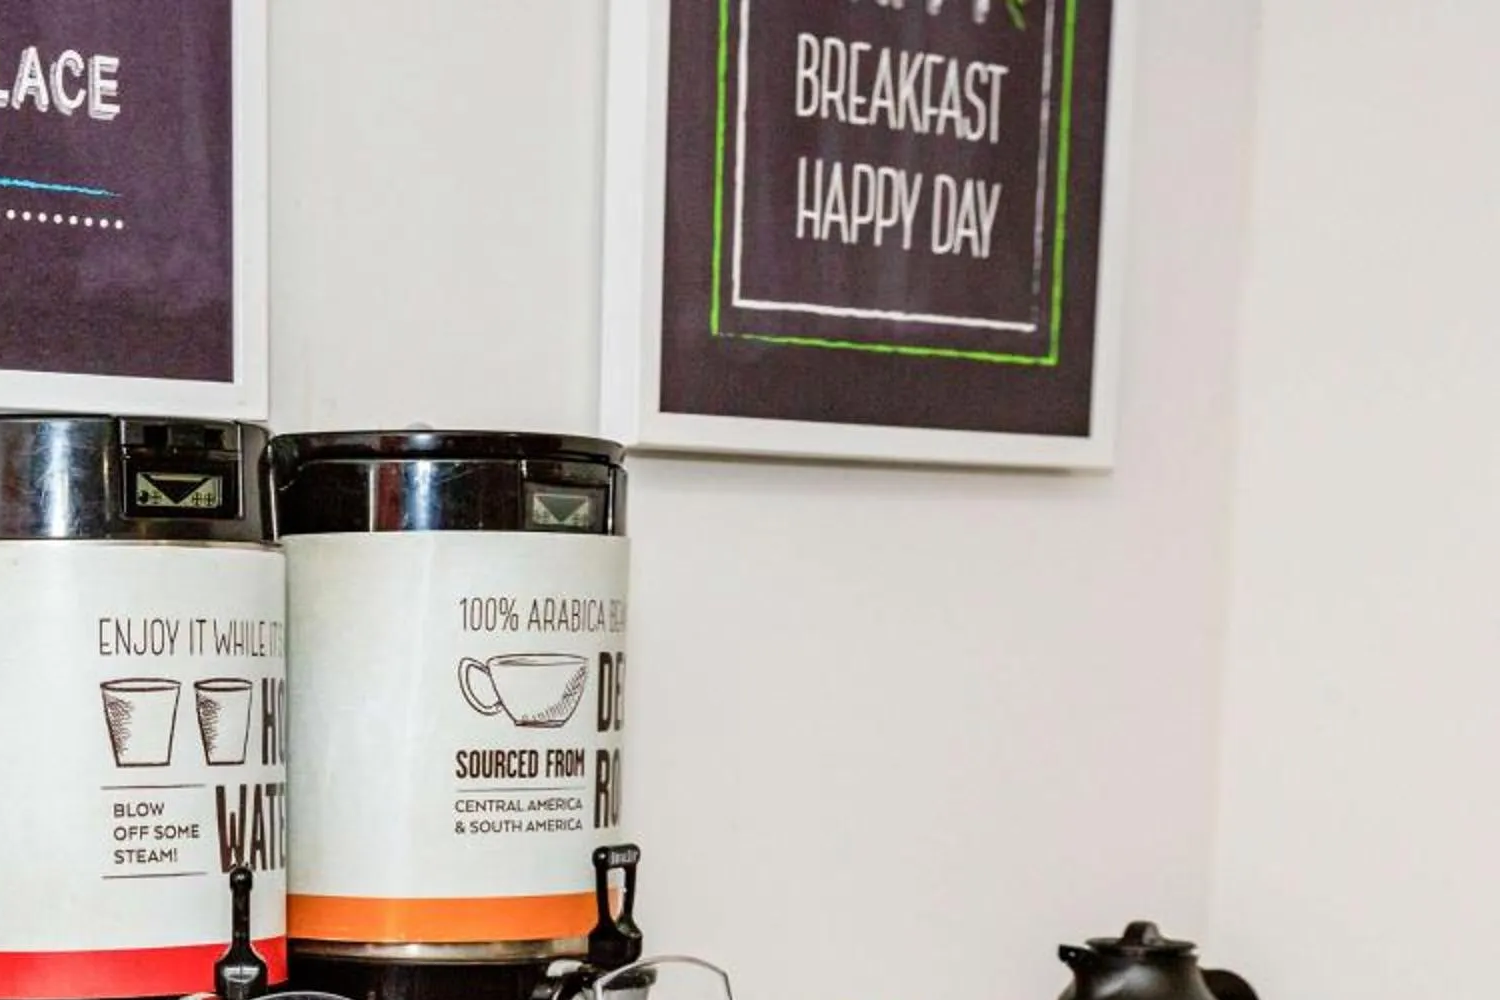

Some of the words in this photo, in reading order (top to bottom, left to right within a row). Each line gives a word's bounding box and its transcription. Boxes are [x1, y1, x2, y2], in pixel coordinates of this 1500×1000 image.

[796, 33, 1009, 144] BREAKFAST
[796, 157, 923, 250] HAPPY
[931, 174, 1002, 258] DAY
[458, 597, 519, 632] 100%
[527, 598, 606, 632] ARABICA
[99, 618, 179, 656] ENJOY
[189, 619, 207, 655] IT
[213, 619, 266, 657] WHILE
[456, 750, 536, 779] SOURCED
[545, 749, 586, 777] FROM
[113, 802, 165, 818] BLOW
[454, 799, 524, 814] CENTRAL
[526, 797, 583, 812] AMERICA
[113, 824, 150, 841] OFF
[154, 823, 201, 840] SOME
[454, 821, 466, 834] &
[469, 821, 522, 834] SOUTH
[525, 818, 583, 833] AMERICA
[113, 847, 178, 864] STEAM!
